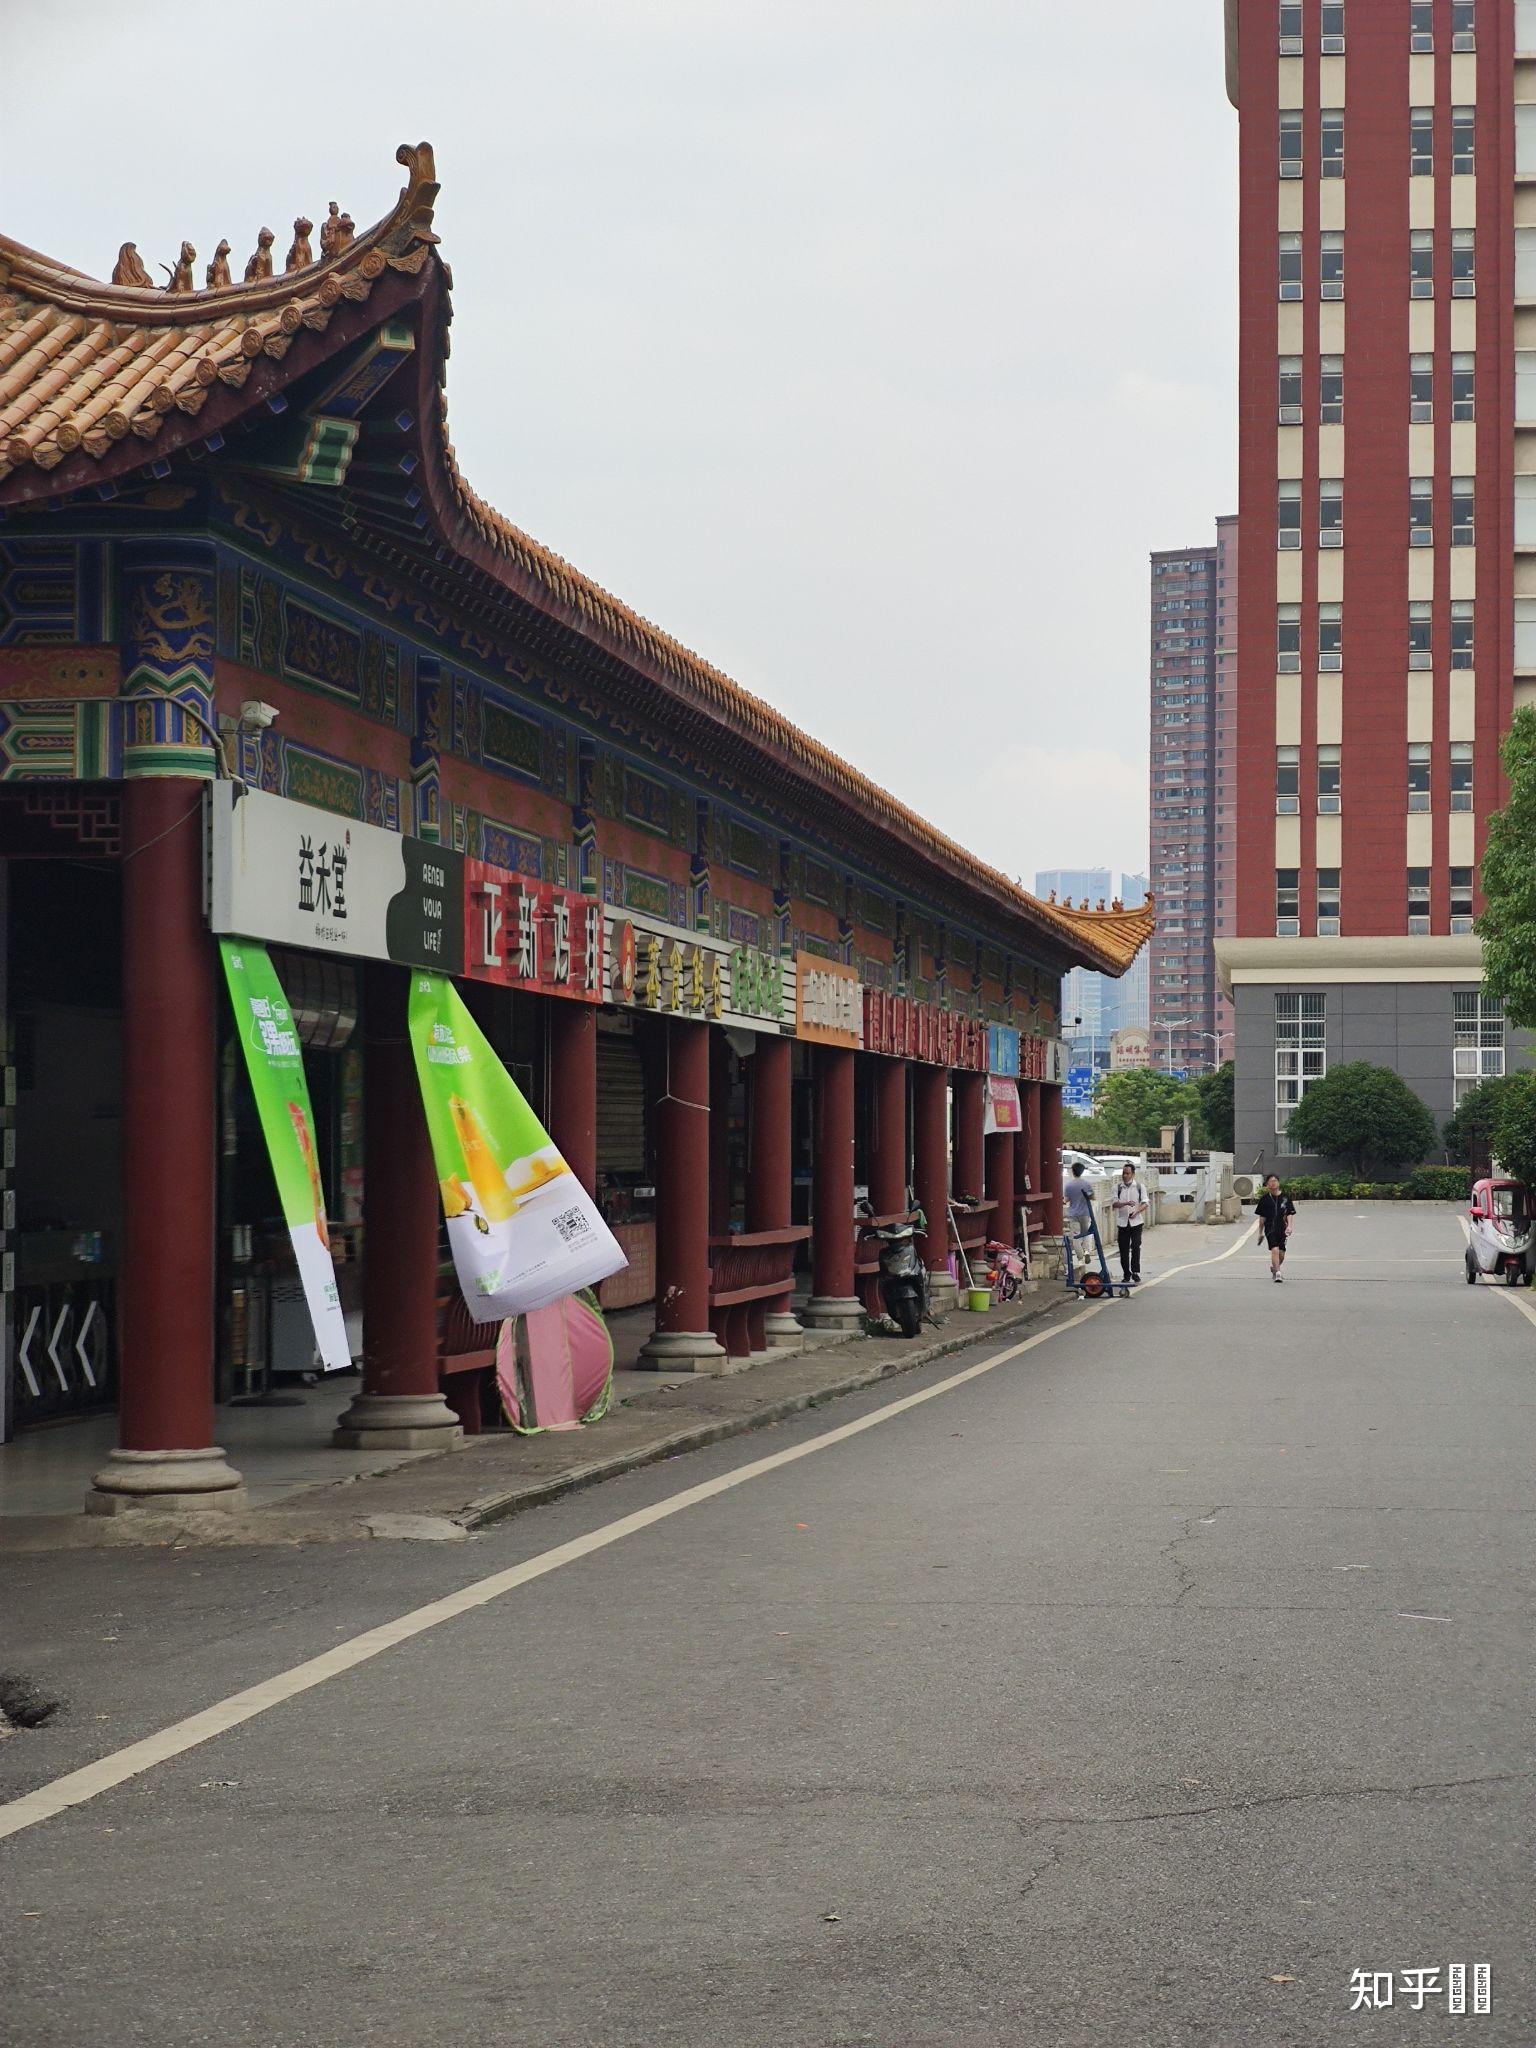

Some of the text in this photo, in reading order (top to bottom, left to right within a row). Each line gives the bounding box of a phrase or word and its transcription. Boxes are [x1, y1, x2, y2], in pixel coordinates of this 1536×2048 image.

[298, 834, 348, 919] 益禾堂
[422, 863, 445, 888] RENEW
[423, 897, 442, 920] YOUR
[423, 930, 438, 951] LIFE
[483, 881, 602, 990] 正新鸡排
